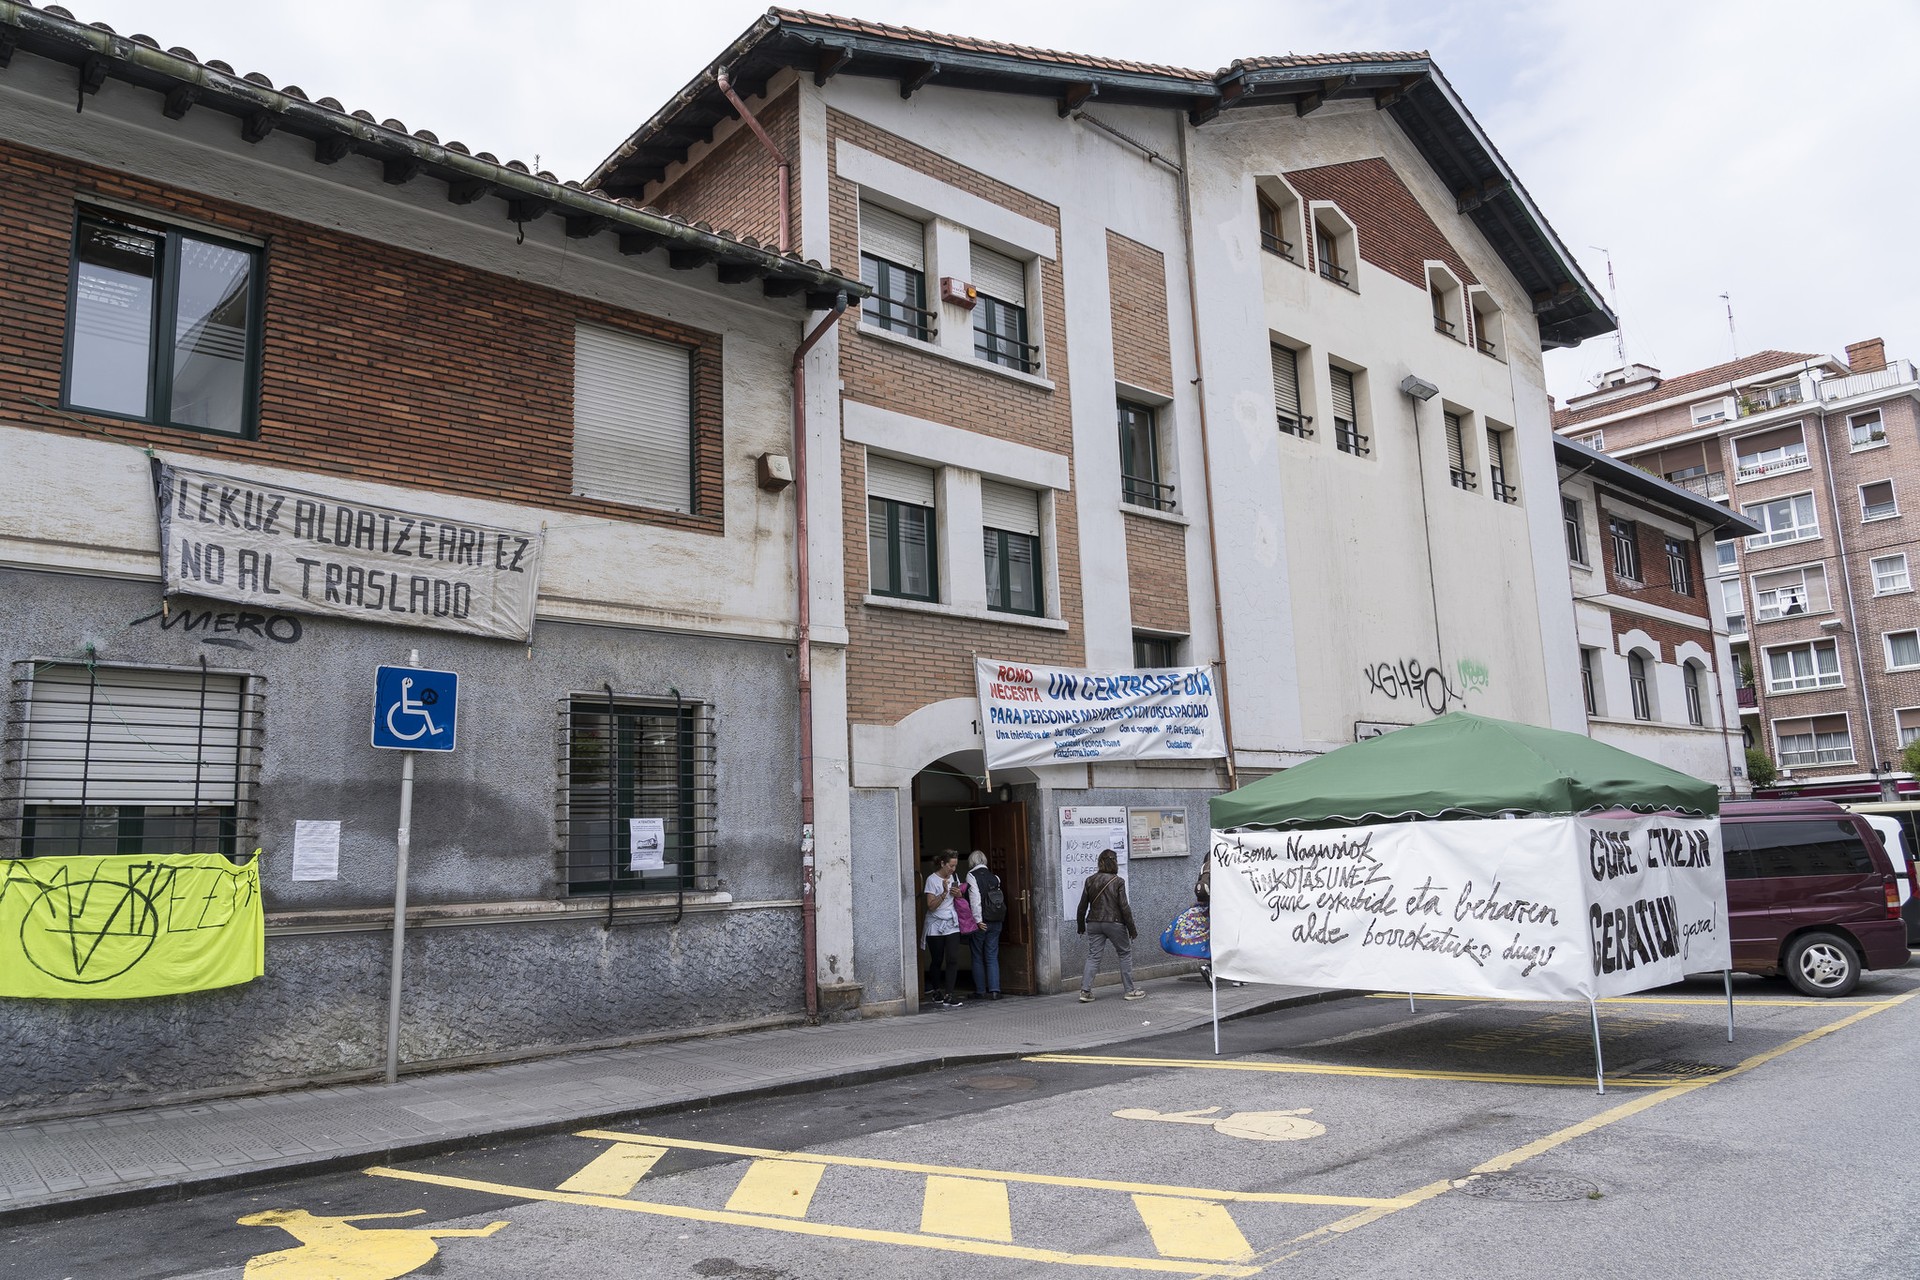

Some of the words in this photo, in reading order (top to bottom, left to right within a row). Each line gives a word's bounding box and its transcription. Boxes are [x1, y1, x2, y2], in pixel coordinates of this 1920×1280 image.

[178, 479, 285, 535] LEKUZ
[294, 500, 484, 566] ALDATZEARI
[496, 534, 529, 572] EZ
[181, 539, 225, 585] NO
[238, 549, 280, 595] AL
[296, 557, 471, 618] TRASLADO
[997, 665, 1033, 683] ROMO
[990, 683, 1043, 702] NECESITA
[1048, 673, 1078, 700] UN
[990, 707, 1021, 724] PARA
[1022, 708, 1081, 725] PERSONAS
[1080, 706, 1123, 723] MAYORES
[996, 730, 1010, 740] Una
[1011, 729, 1041, 740] iniciativa
[1119, 724, 1130, 733] Con
[1589, 828, 1638, 881] GURE
[1406, 876, 1448, 915] eta
